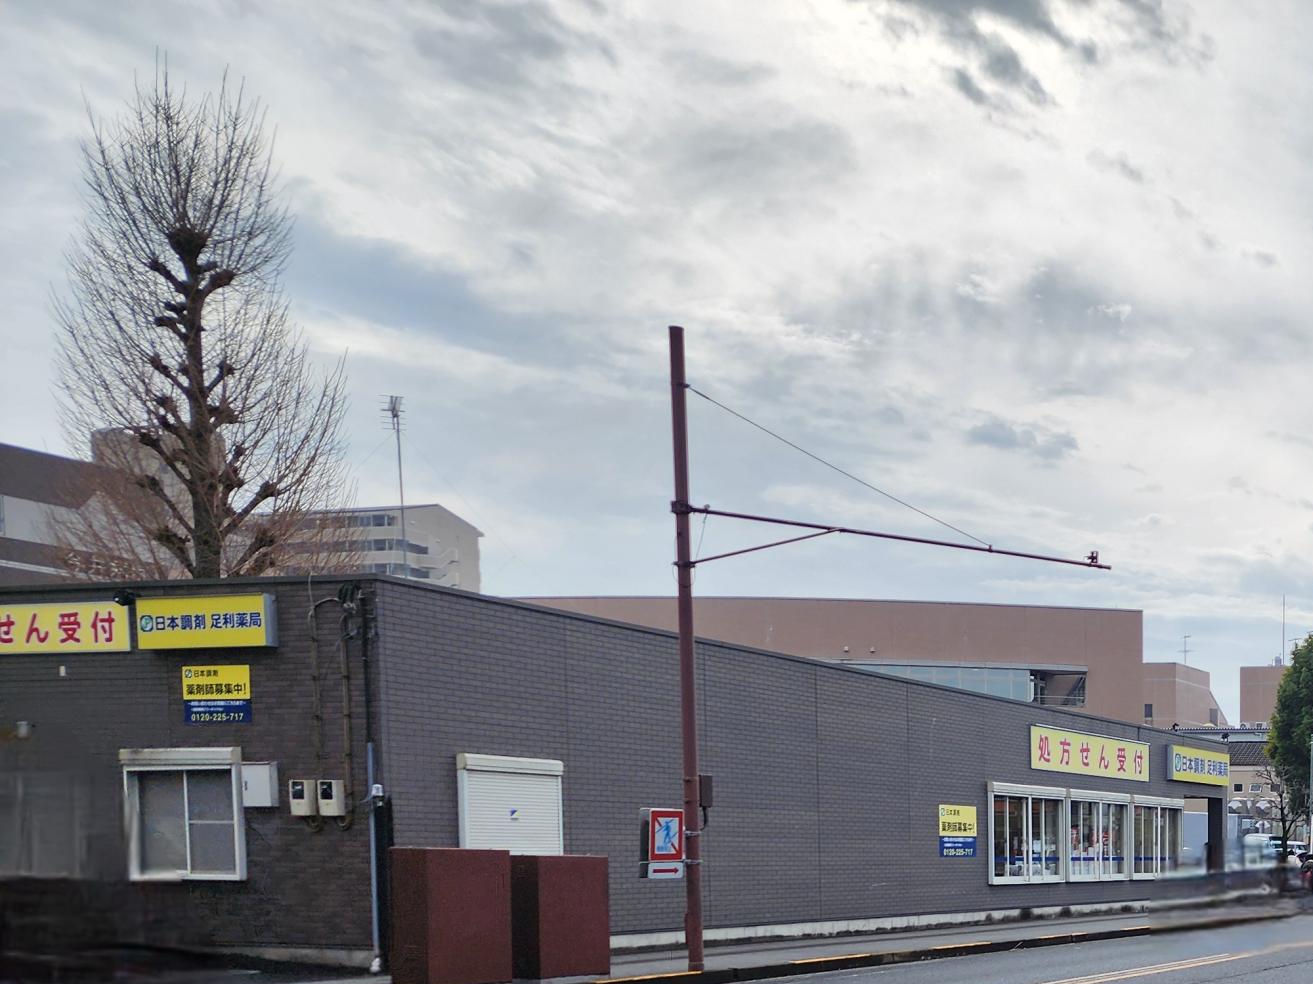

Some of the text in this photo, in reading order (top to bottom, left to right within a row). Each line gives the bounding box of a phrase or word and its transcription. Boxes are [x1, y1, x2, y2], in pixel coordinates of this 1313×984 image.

[156, 612, 262, 631] 日本調剤 足利薬局
[191, 713, 244, 721] 0120-225-717
[1038, 734, 1144, 775] 処方せん受付
